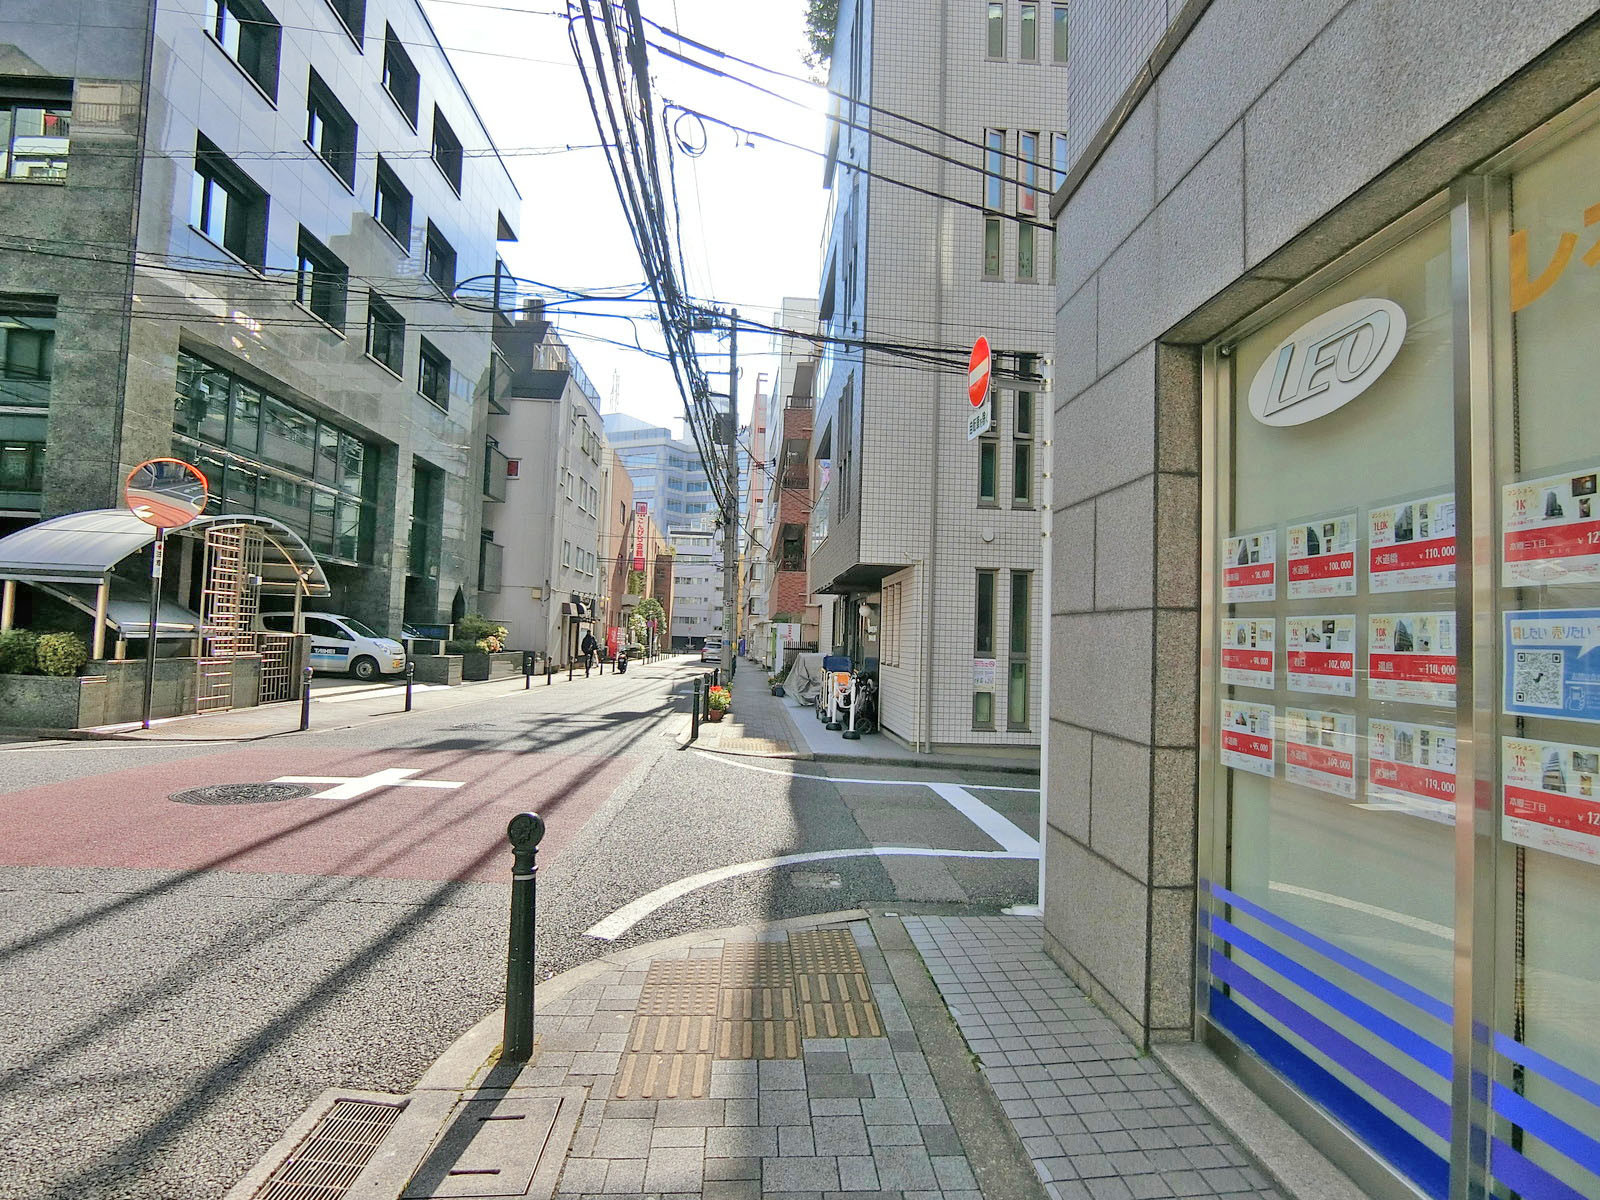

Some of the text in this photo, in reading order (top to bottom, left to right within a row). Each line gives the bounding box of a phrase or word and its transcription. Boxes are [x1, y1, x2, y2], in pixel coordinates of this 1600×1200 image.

[1263, 309, 1391, 417] LEO
[1515, 500, 1526, 511] 1K
[1375, 552, 1398, 565] 水道橋
[1512, 625, 1592, 640] 貸したい 売りたい
[1515, 754, 1526, 767] 1K
